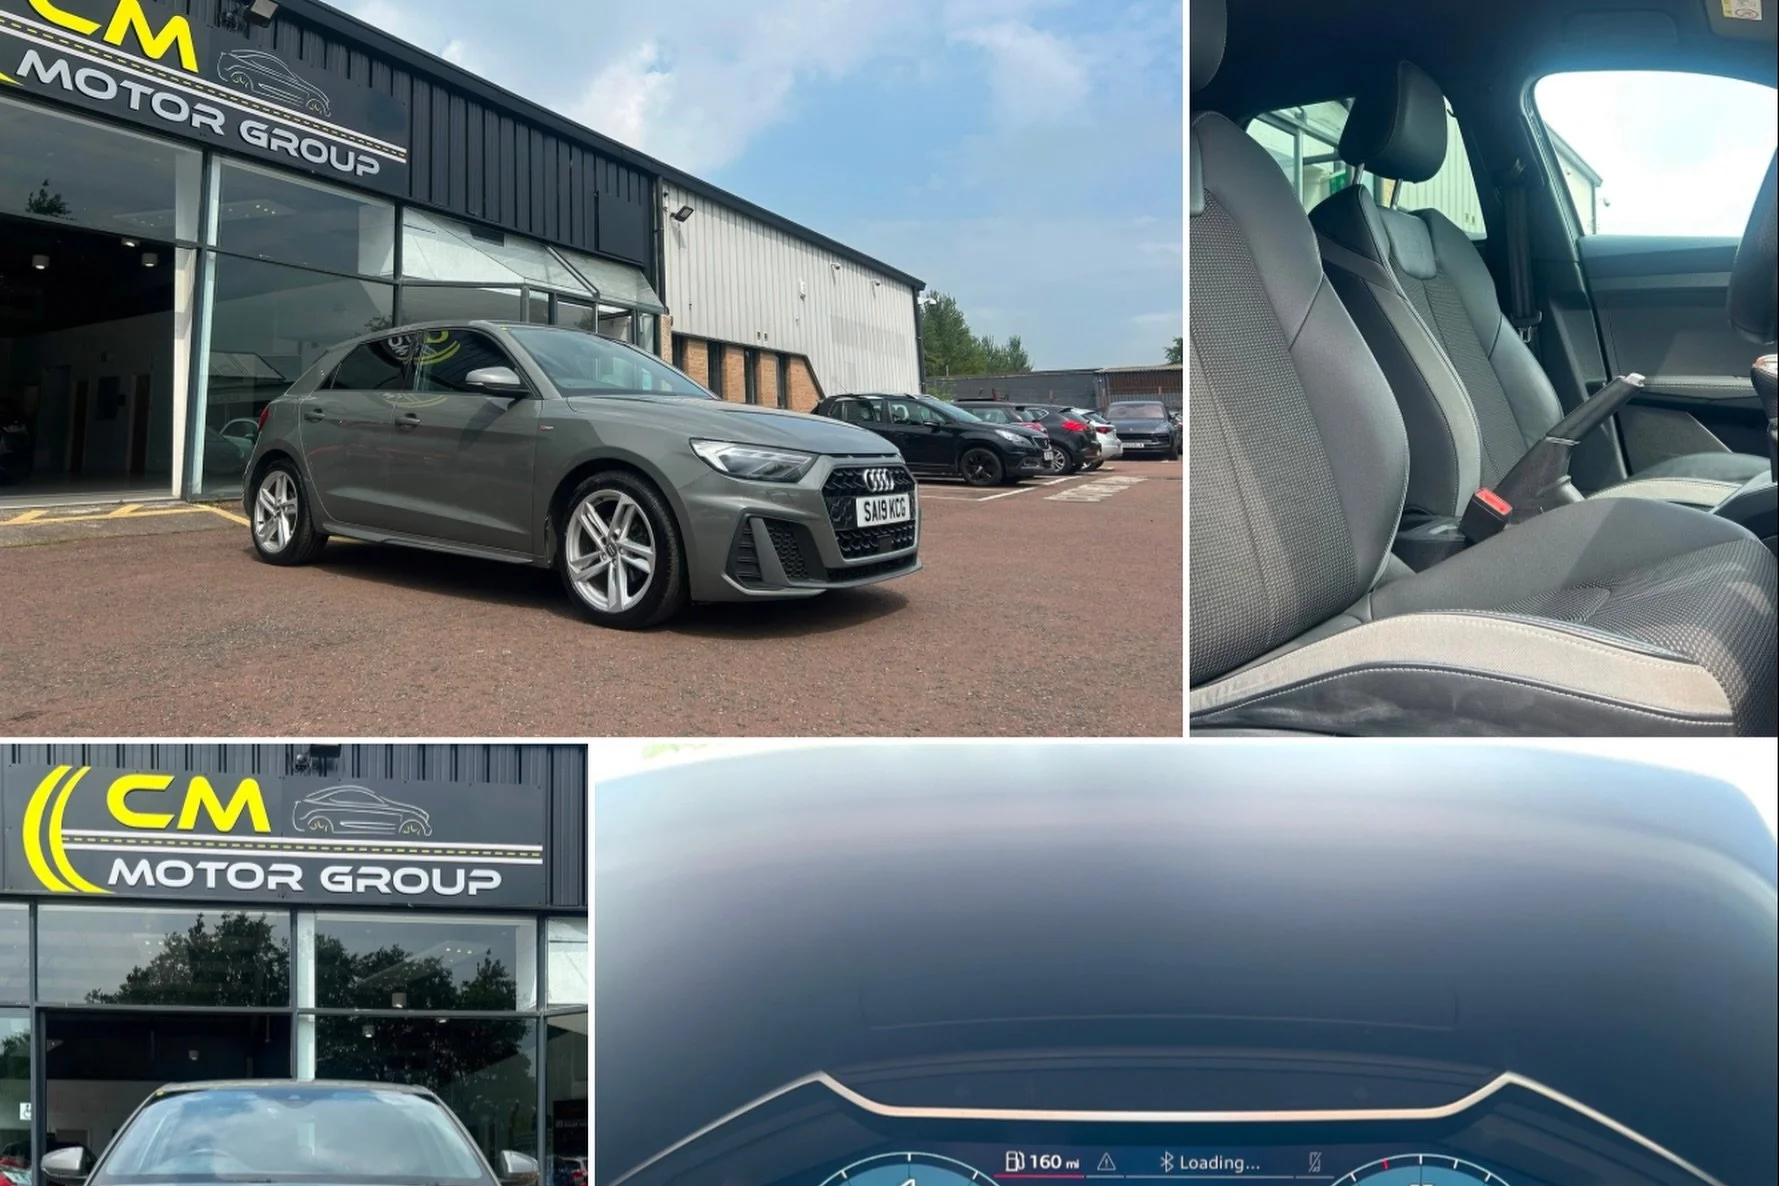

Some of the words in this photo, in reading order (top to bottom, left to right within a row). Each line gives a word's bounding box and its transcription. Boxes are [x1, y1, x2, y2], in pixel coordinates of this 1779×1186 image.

[16, 49, 225, 135] MOTOR
[240, 120, 380, 176] GROUP
[863, 500, 888, 522] SA19
[889, 497, 906, 519] KCG
[106, 774, 271, 833] CM
[107, 858, 304, 893] MOTOR
[320, 866, 502, 896] GROUP
[1029, 1154, 1062, 1169] 160
[1066, 1158, 1080, 1169] mi
[1180, 1155, 1261, 1173] Loading...
